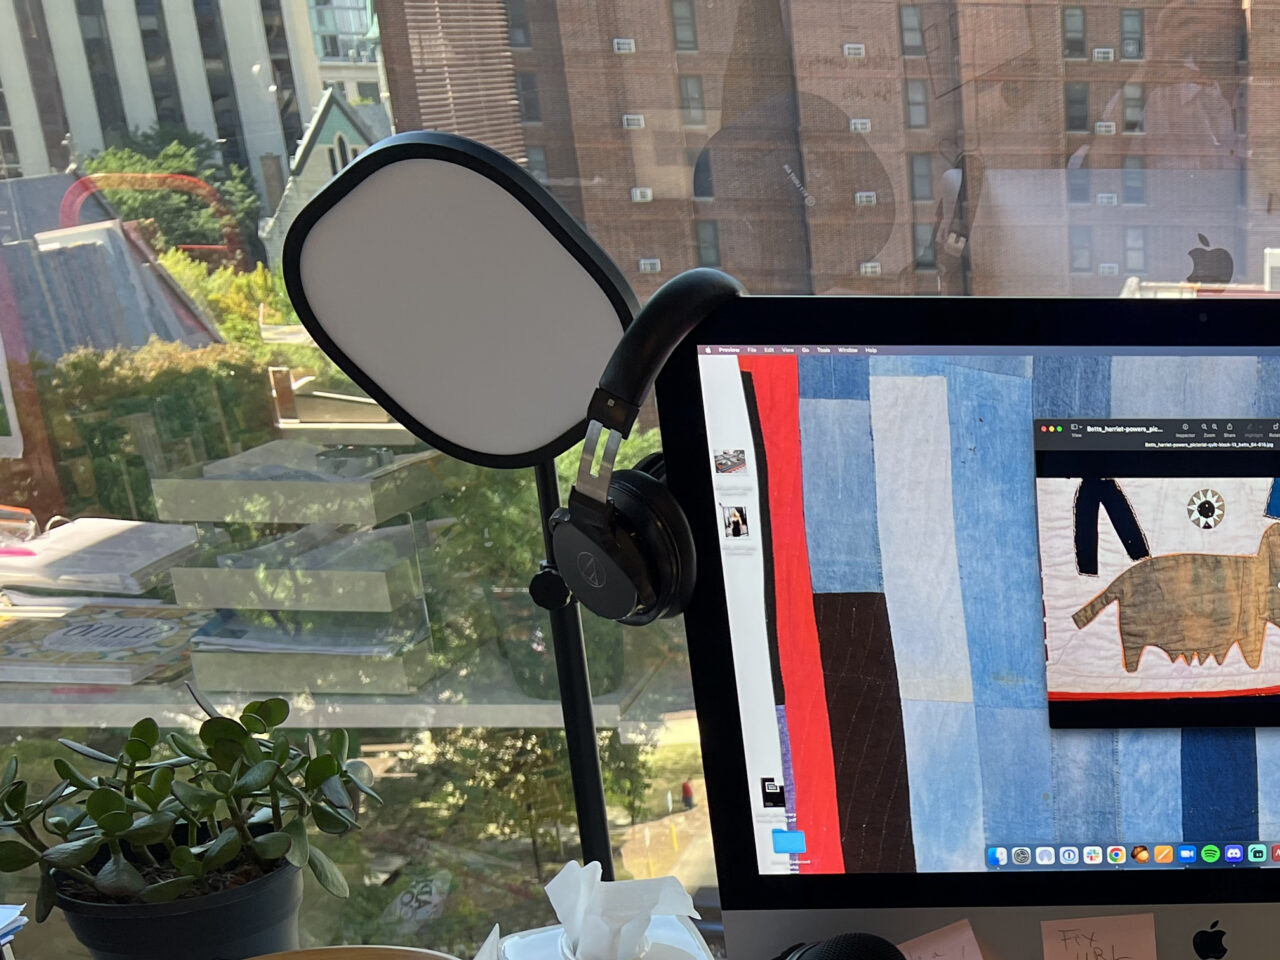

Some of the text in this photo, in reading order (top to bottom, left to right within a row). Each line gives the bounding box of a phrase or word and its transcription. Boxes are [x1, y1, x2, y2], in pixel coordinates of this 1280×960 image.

[718, 346, 878, 354] Preview File Edit View Go Tools Window Help
[1057, 929, 1096, 950] Fix
